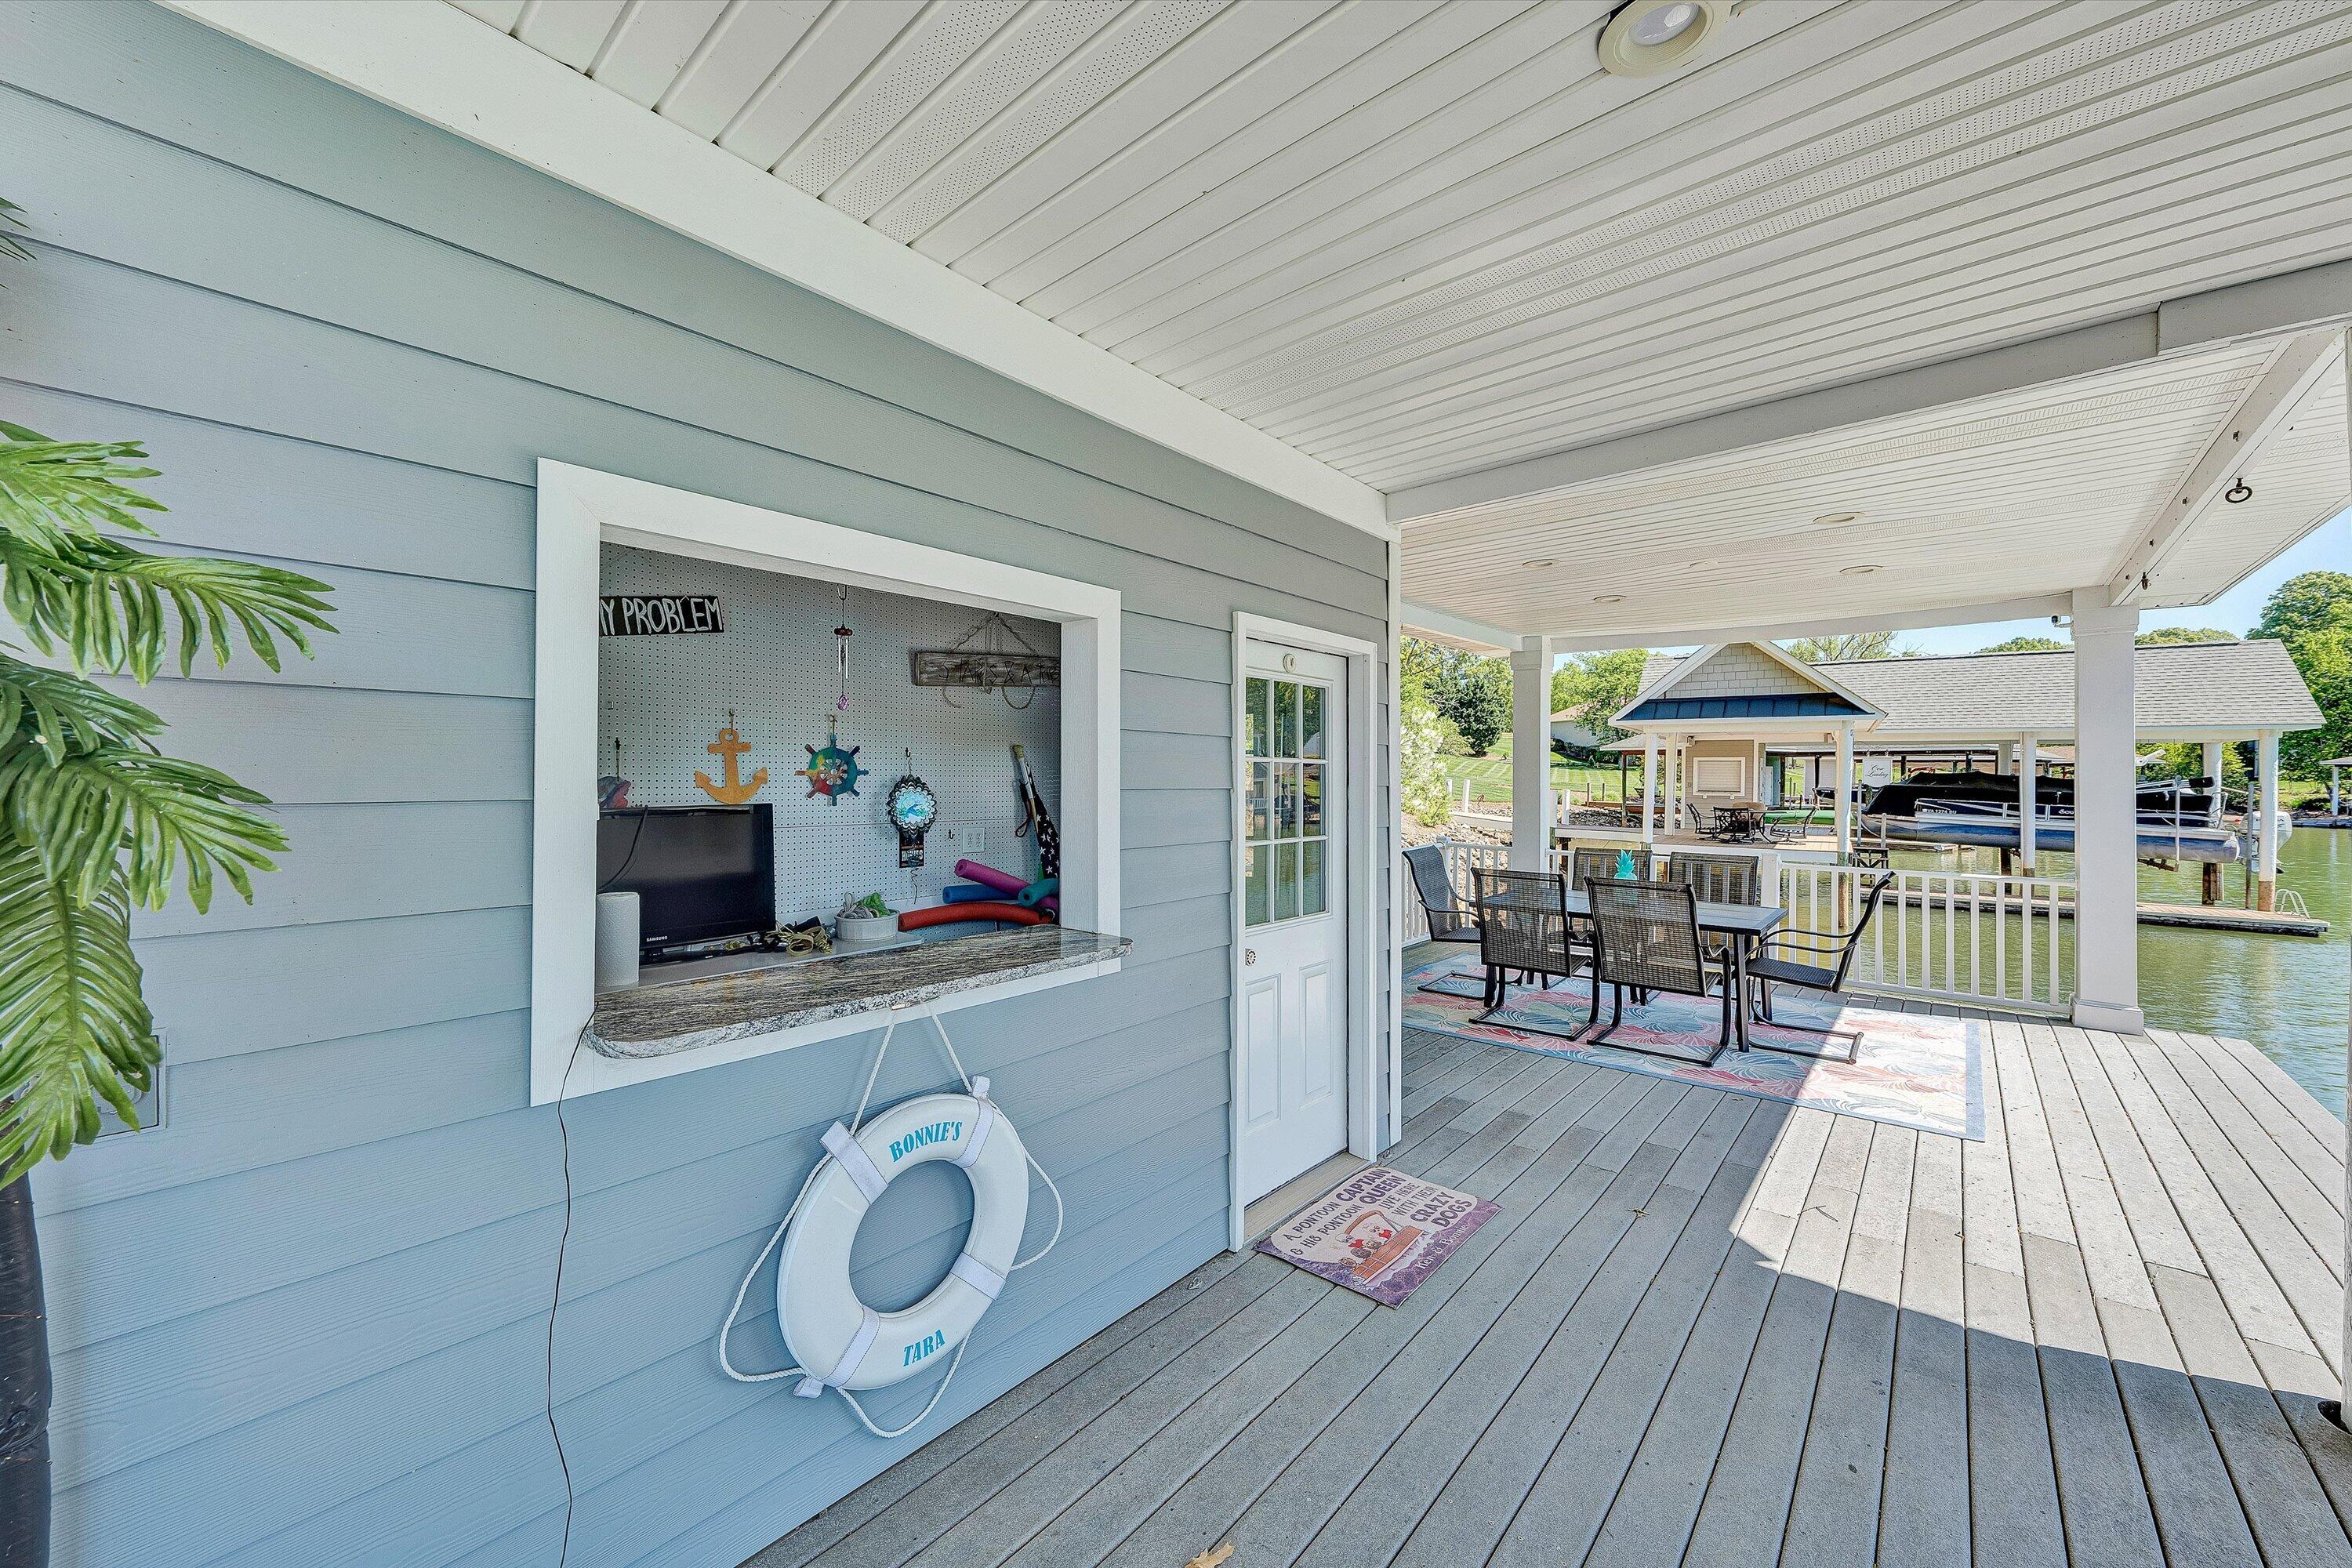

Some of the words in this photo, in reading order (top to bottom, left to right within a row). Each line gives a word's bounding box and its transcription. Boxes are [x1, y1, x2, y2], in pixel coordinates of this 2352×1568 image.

[622, 597, 724, 634] PROBLEM
[1020, 664, 1033, 684] A
[889, 1121, 963, 1163] BONNIE'S
[1292, 1201, 1342, 1234] PONTOON
[1335, 1168, 1391, 1202] CAPTAIN
[1317, 1203, 1364, 1236] PONTOON
[1359, 1175, 1406, 1204] QUEEN
[1378, 1195, 1401, 1210] LIVE
[1395, 1182, 1420, 1198] HERE
[1392, 1199, 1419, 1216] WITH
[1411, 1186, 1439, 1201] THEIR
[1410, 1191, 1455, 1222] CRAZY
[1431, 1200, 1472, 1228] DOGS
[1414, 1254, 1436, 1269] Ken
[1431, 1245, 1443, 1254] &
[1439, 1224, 1469, 1245] Bonnie
[903, 1329, 946, 1367] TARA
